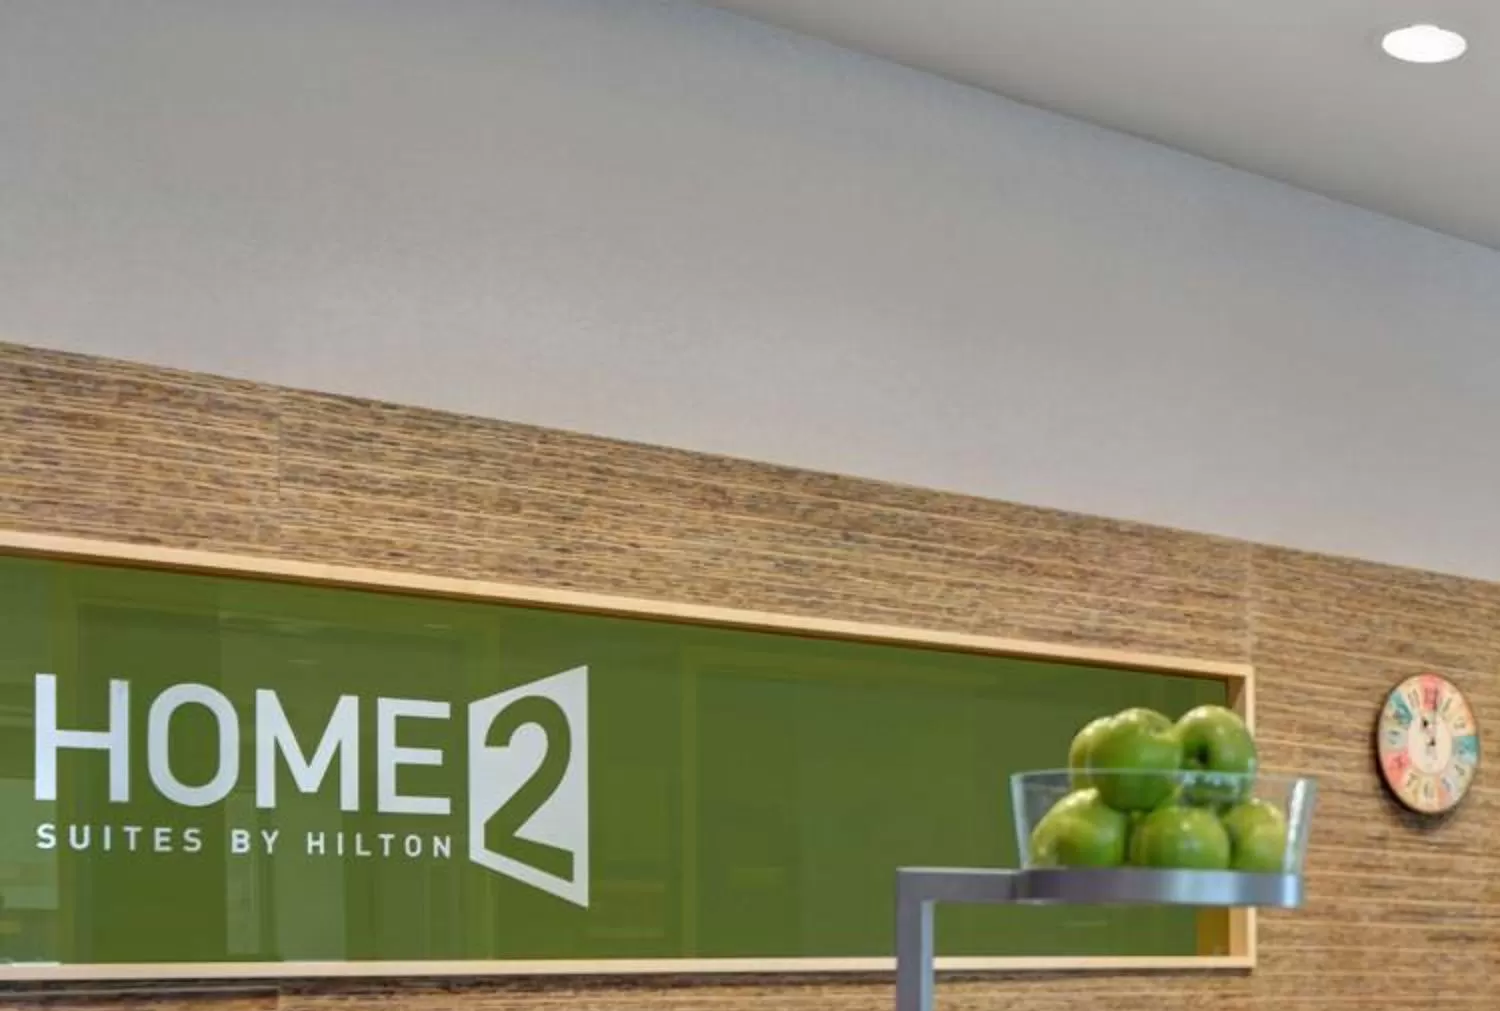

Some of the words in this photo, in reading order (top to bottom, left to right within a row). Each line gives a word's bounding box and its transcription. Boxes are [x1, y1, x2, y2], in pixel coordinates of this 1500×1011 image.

[35, 823, 203, 853] SUITES
[231, 829, 280, 856] BY
[306, 831, 453, 858] HILTON
